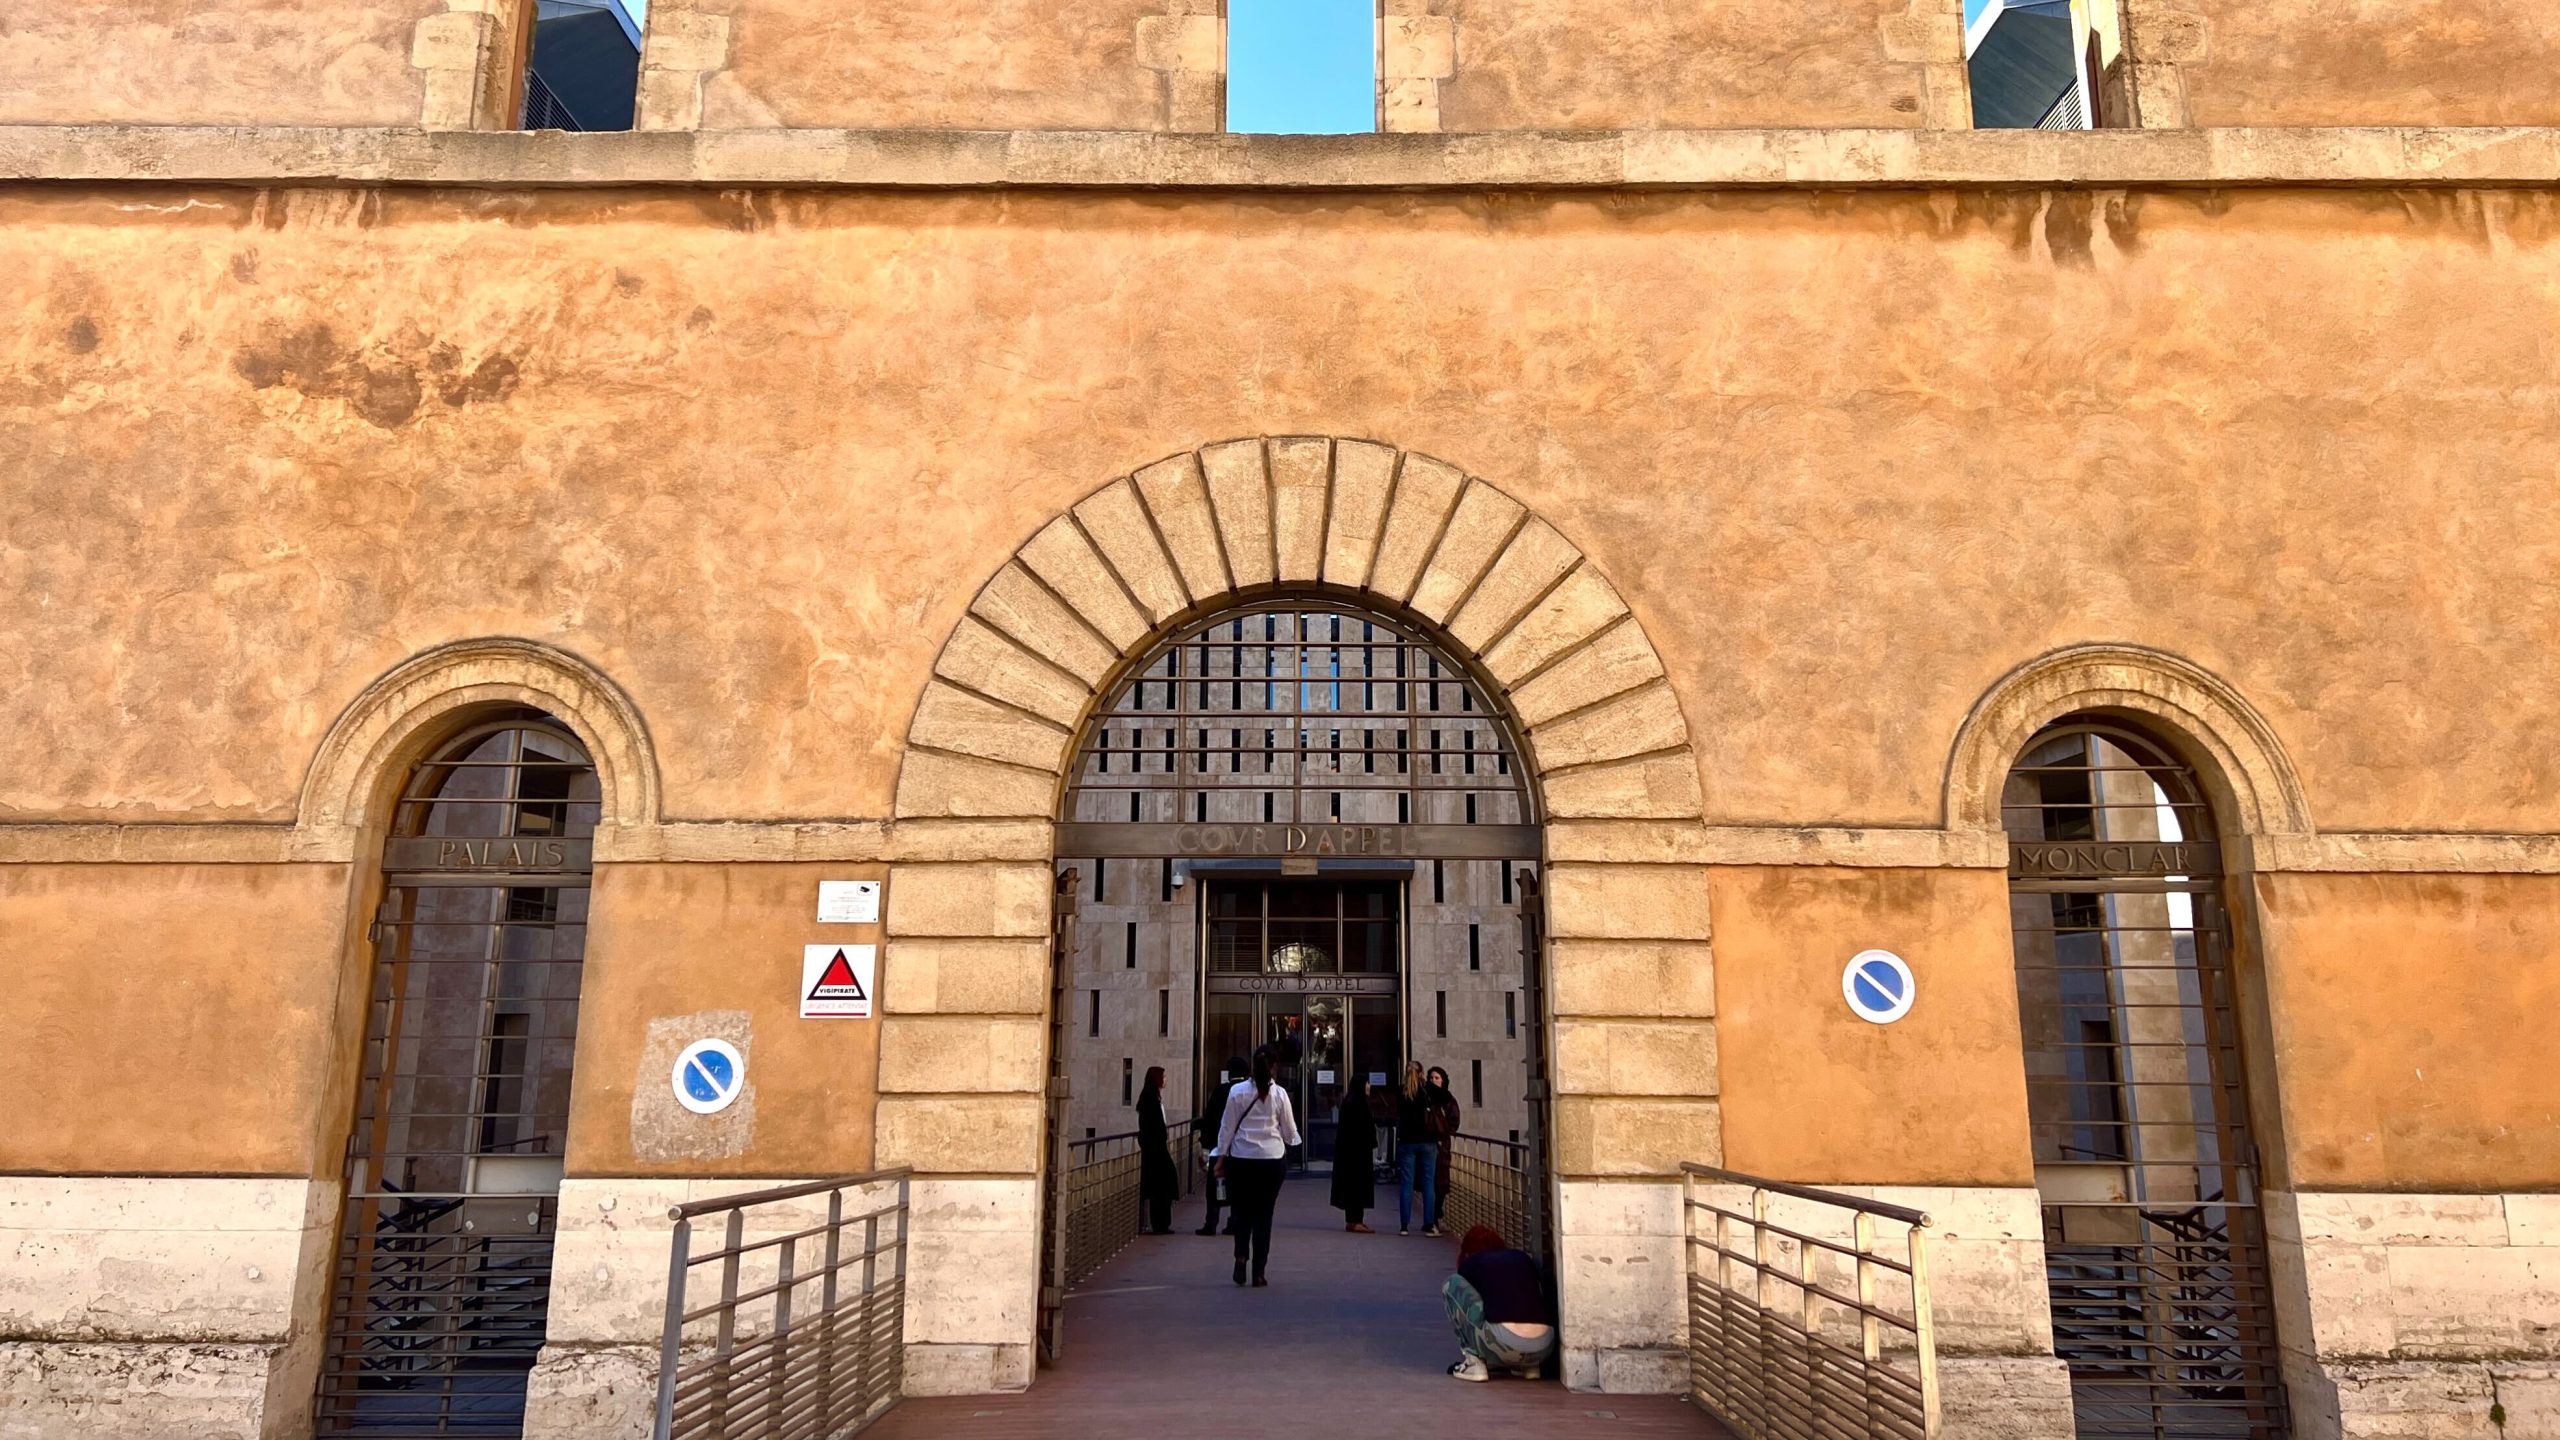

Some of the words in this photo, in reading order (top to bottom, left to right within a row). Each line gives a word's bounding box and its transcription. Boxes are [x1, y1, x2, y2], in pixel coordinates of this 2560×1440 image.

[438, 840, 563, 867] PALAIS
[1286, 826, 1417, 854] D'APPEL
[2018, 846, 2193, 873] MONCLAR
[1239, 978, 1286, 991] COVR
[1298, 978, 1365, 991] D'APPEL
